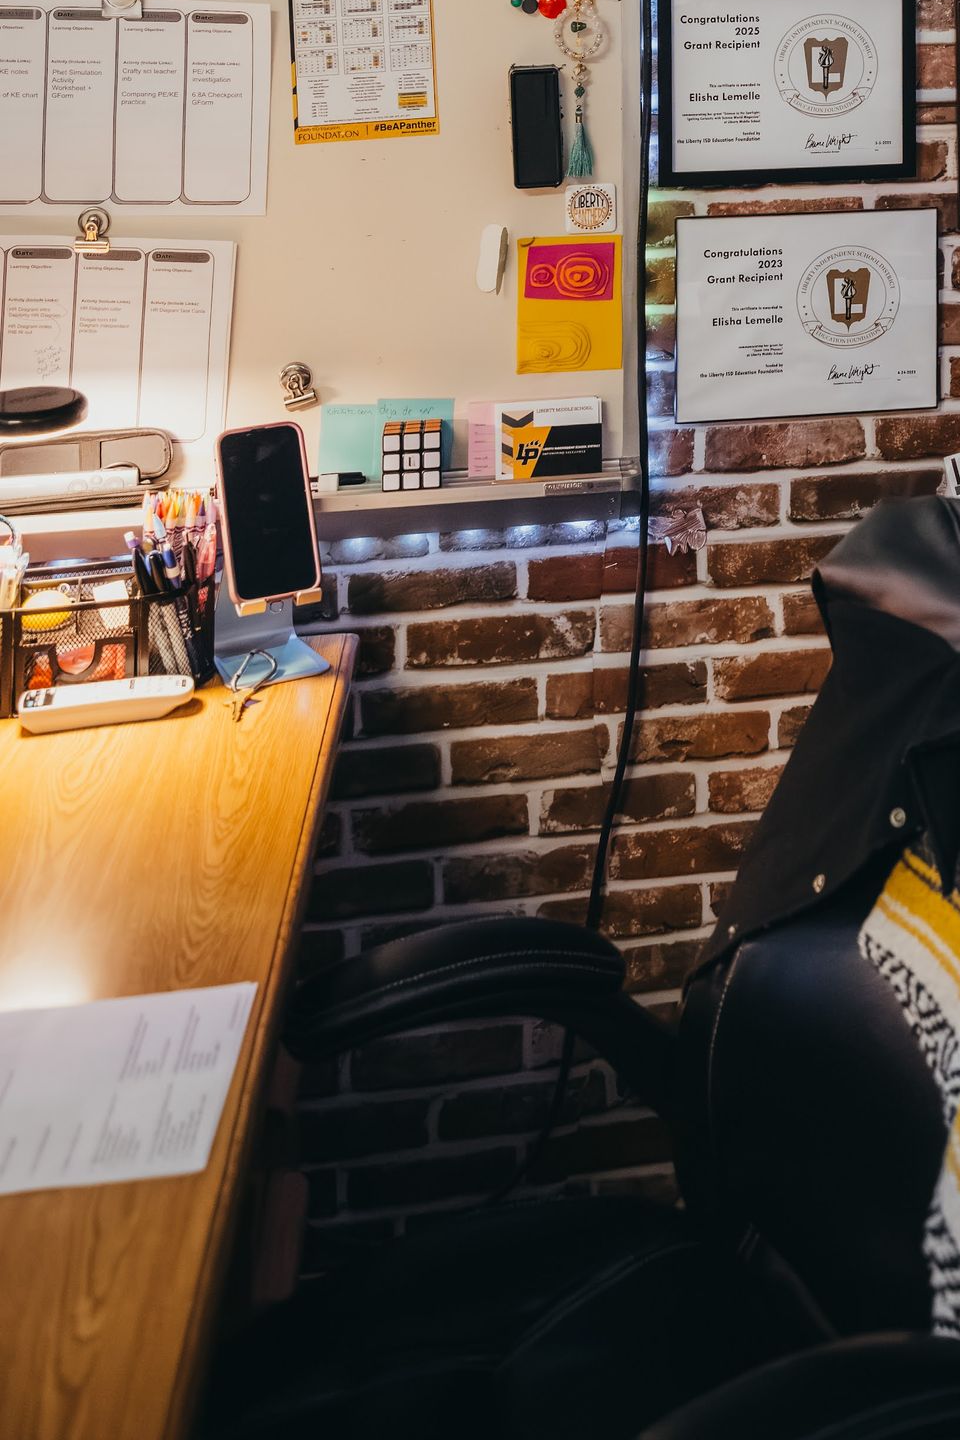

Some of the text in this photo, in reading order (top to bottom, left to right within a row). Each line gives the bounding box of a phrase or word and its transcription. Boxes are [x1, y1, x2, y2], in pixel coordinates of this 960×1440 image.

[680, 14, 760, 25] Congratulations
[735, 27, 760, 36] 2025
[684, 40, 760, 51] Grant Recipient
[689, 91, 760, 102] Elisha Lemelle
[374, 120, 437, 132] #BeAPanther
[573, 192, 605, 209] LIBERTY
[704, 247, 783, 259] Congratulations
[758, 259, 783, 269] 2023
[707, 272, 783, 284] Grant Recipient
[712, 315, 783, 326] Elisha Lemelle
[516, 443, 540, 466] LP
